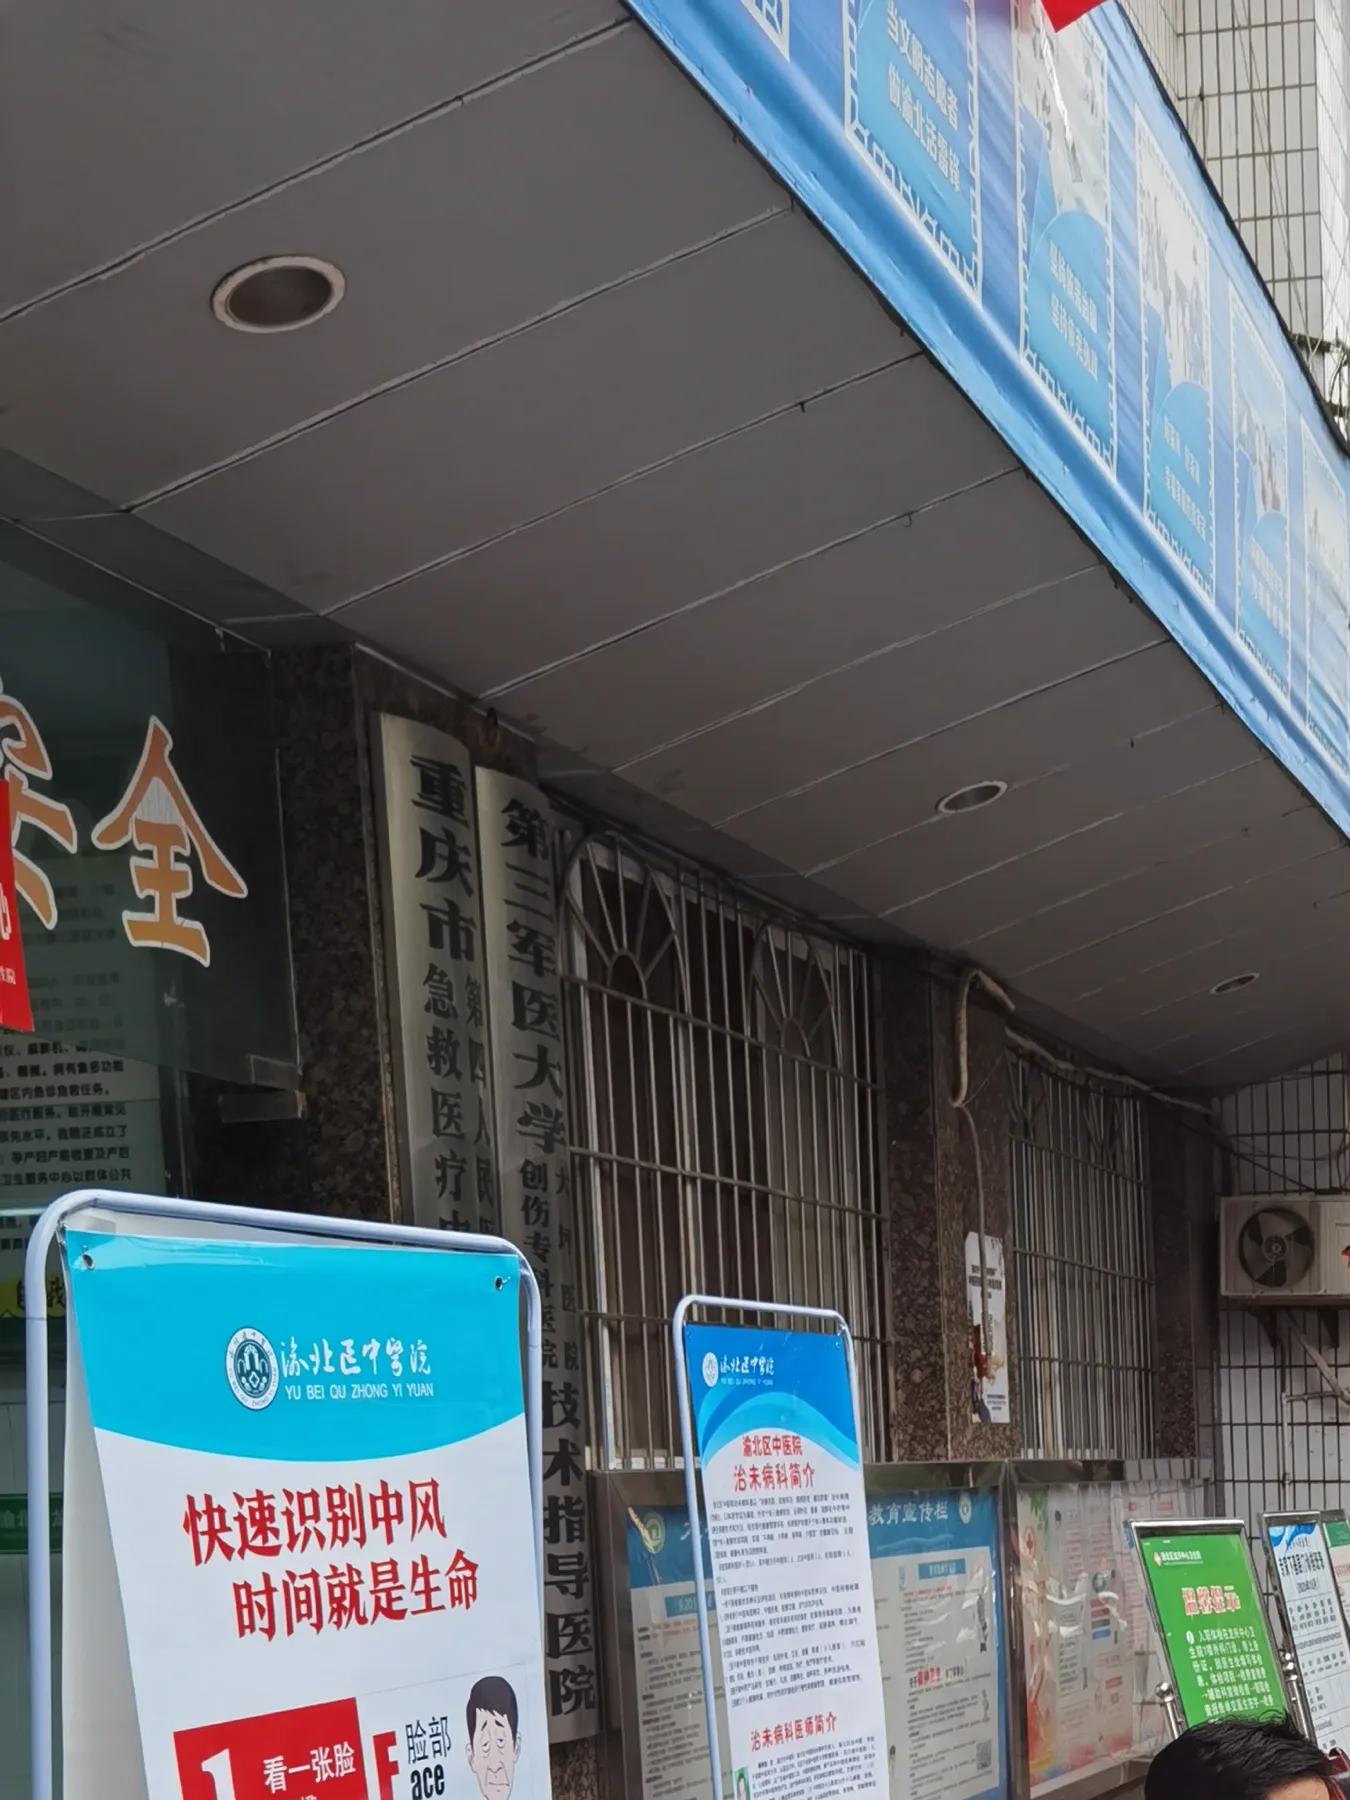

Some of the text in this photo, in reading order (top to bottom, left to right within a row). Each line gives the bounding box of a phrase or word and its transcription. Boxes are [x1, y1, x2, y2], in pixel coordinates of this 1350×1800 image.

[410, 753, 476, 964] 重庆市
[501, 798, 568, 1155] 第三军医大学
[284, 1382, 434, 1401] YU BEI QU ZHONG YI YUAN
[742, 1434, 804, 1458] 渝北区中医院
[733, 1461, 816, 1493] 治未病科简介
[182, 1478, 447, 1567] 快速识别中风
[869, 1500, 949, 1526] 教育宣传栏
[541, 1378, 598, 1717] 技术指导医院
[231, 1548, 480, 1642] 时间就是生命
[1181, 1584, 1242, 1618] 温馨提示
[405, 1715, 452, 1765] 脸部
[750, 1709, 839, 1753] 治未病科医师简介
[263, 1743, 357, 1794] 看一张脸
